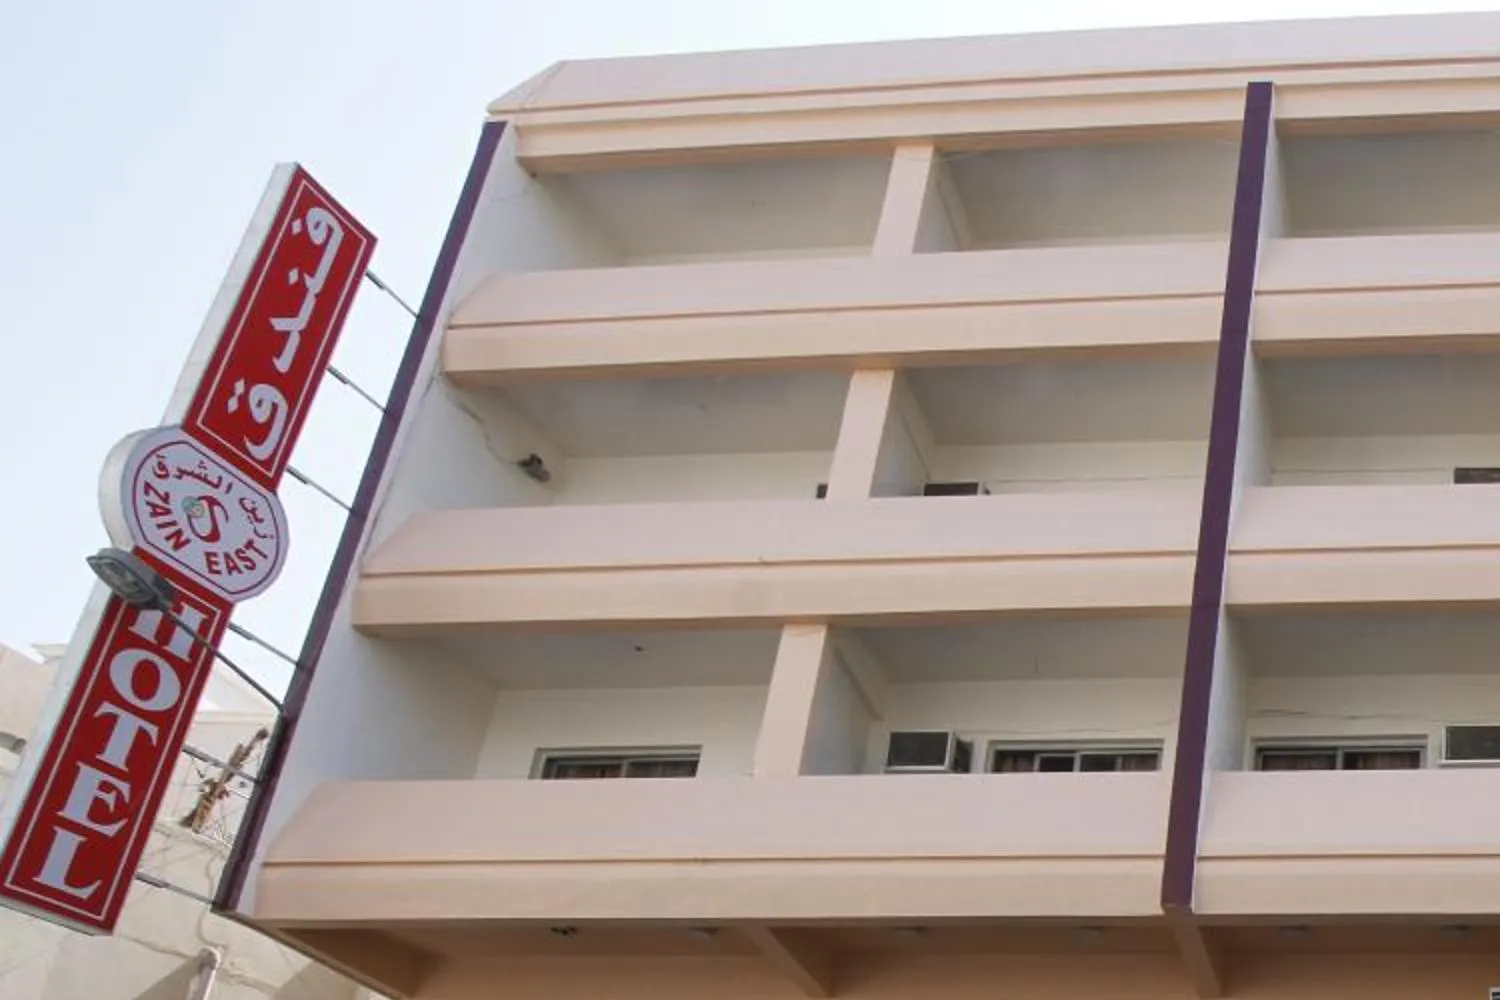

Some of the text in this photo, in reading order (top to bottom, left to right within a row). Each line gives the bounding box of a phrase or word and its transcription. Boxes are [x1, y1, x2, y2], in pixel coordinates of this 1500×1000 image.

[227, 205, 346, 462] فندق
[143, 479, 268, 576] ZAIN EAST
[33, 601, 208, 899] HOTEL
